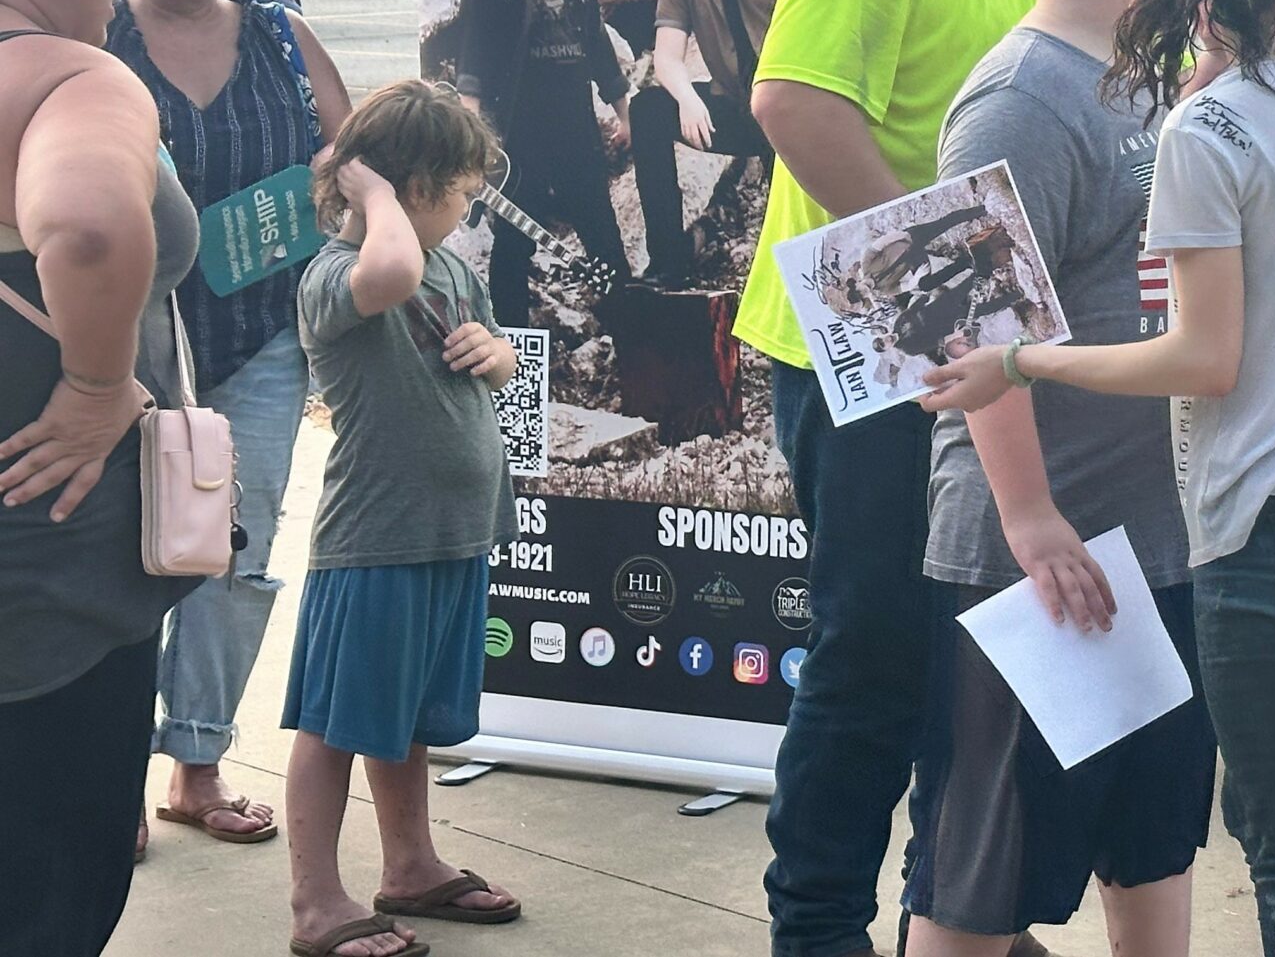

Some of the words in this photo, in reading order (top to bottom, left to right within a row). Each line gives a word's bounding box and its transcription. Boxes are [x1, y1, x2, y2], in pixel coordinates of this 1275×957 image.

[657, 505, 809, 560] SPONSORS
[628, 573, 661, 593] HLI
[533, 635, 563, 647] music
